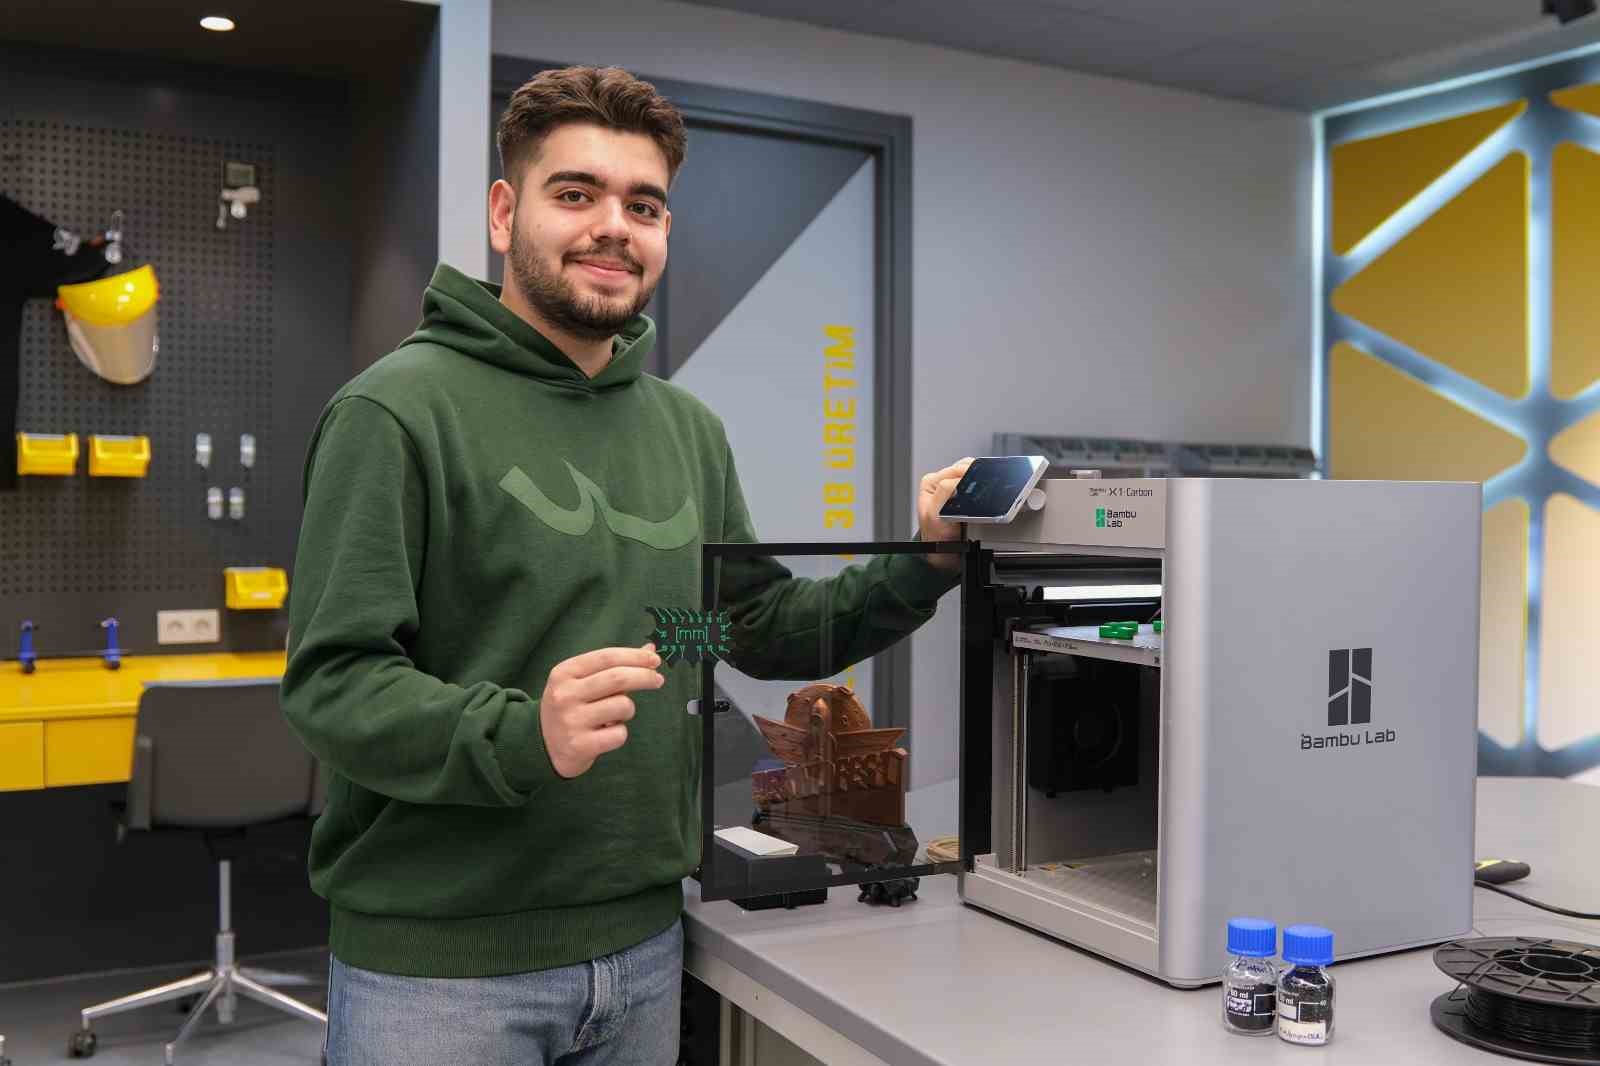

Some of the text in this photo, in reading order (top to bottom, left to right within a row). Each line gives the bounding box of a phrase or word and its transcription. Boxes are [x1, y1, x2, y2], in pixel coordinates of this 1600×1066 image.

[1108, 487, 1123, 497] X1
[1126, 487, 1153, 497] Carbon
[823, 482, 856, 529] 3B
[1106, 509, 1137, 519] Bambu
[1106, 519, 1123, 528] Lab
[1300, 728, 1397, 750] Bambu Lab
